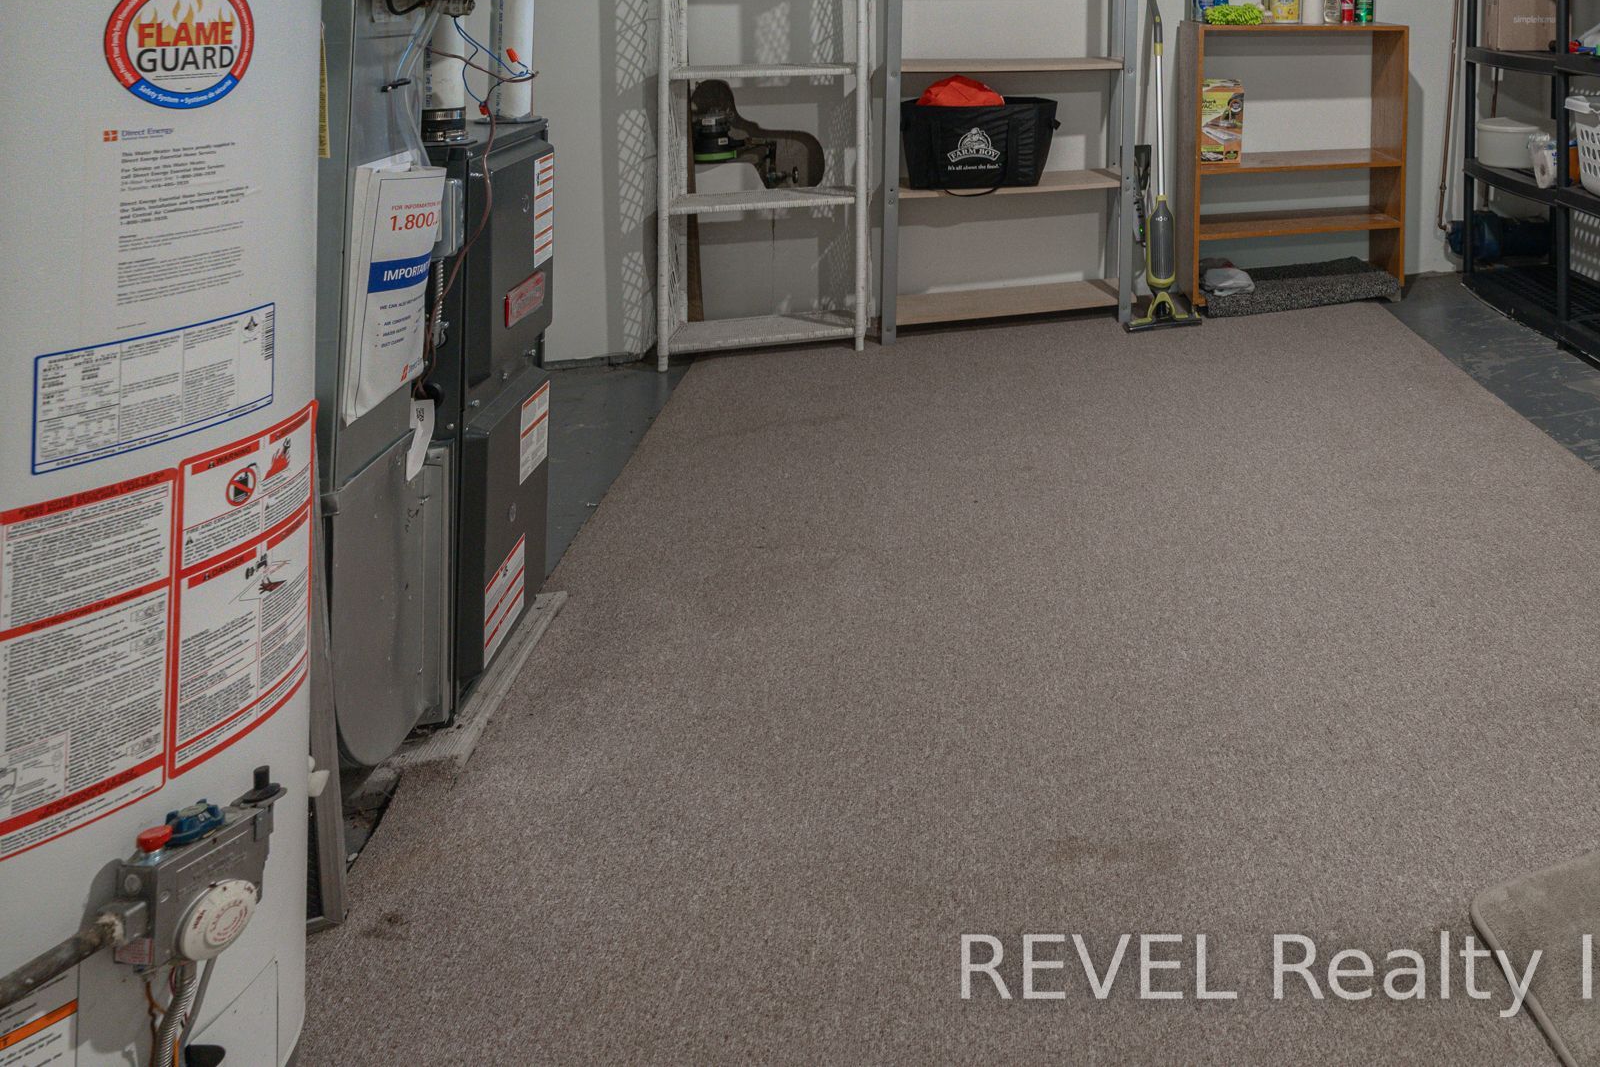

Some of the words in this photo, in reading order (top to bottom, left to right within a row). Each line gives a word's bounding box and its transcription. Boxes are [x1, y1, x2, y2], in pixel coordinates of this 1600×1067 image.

[1513, 15, 1556, 25] simplehuma
[137, 21, 233, 48] FLAME
[136, 45, 235, 73] GUARD
[138, 85, 158, 98] Safety
[121, 129, 145, 137] Direct
[147, 127, 174, 135] Energy
[950, 148, 977, 159] FARM
[979, 148, 998, 158] BOY
[210, 555, 245, 577] DANGER
